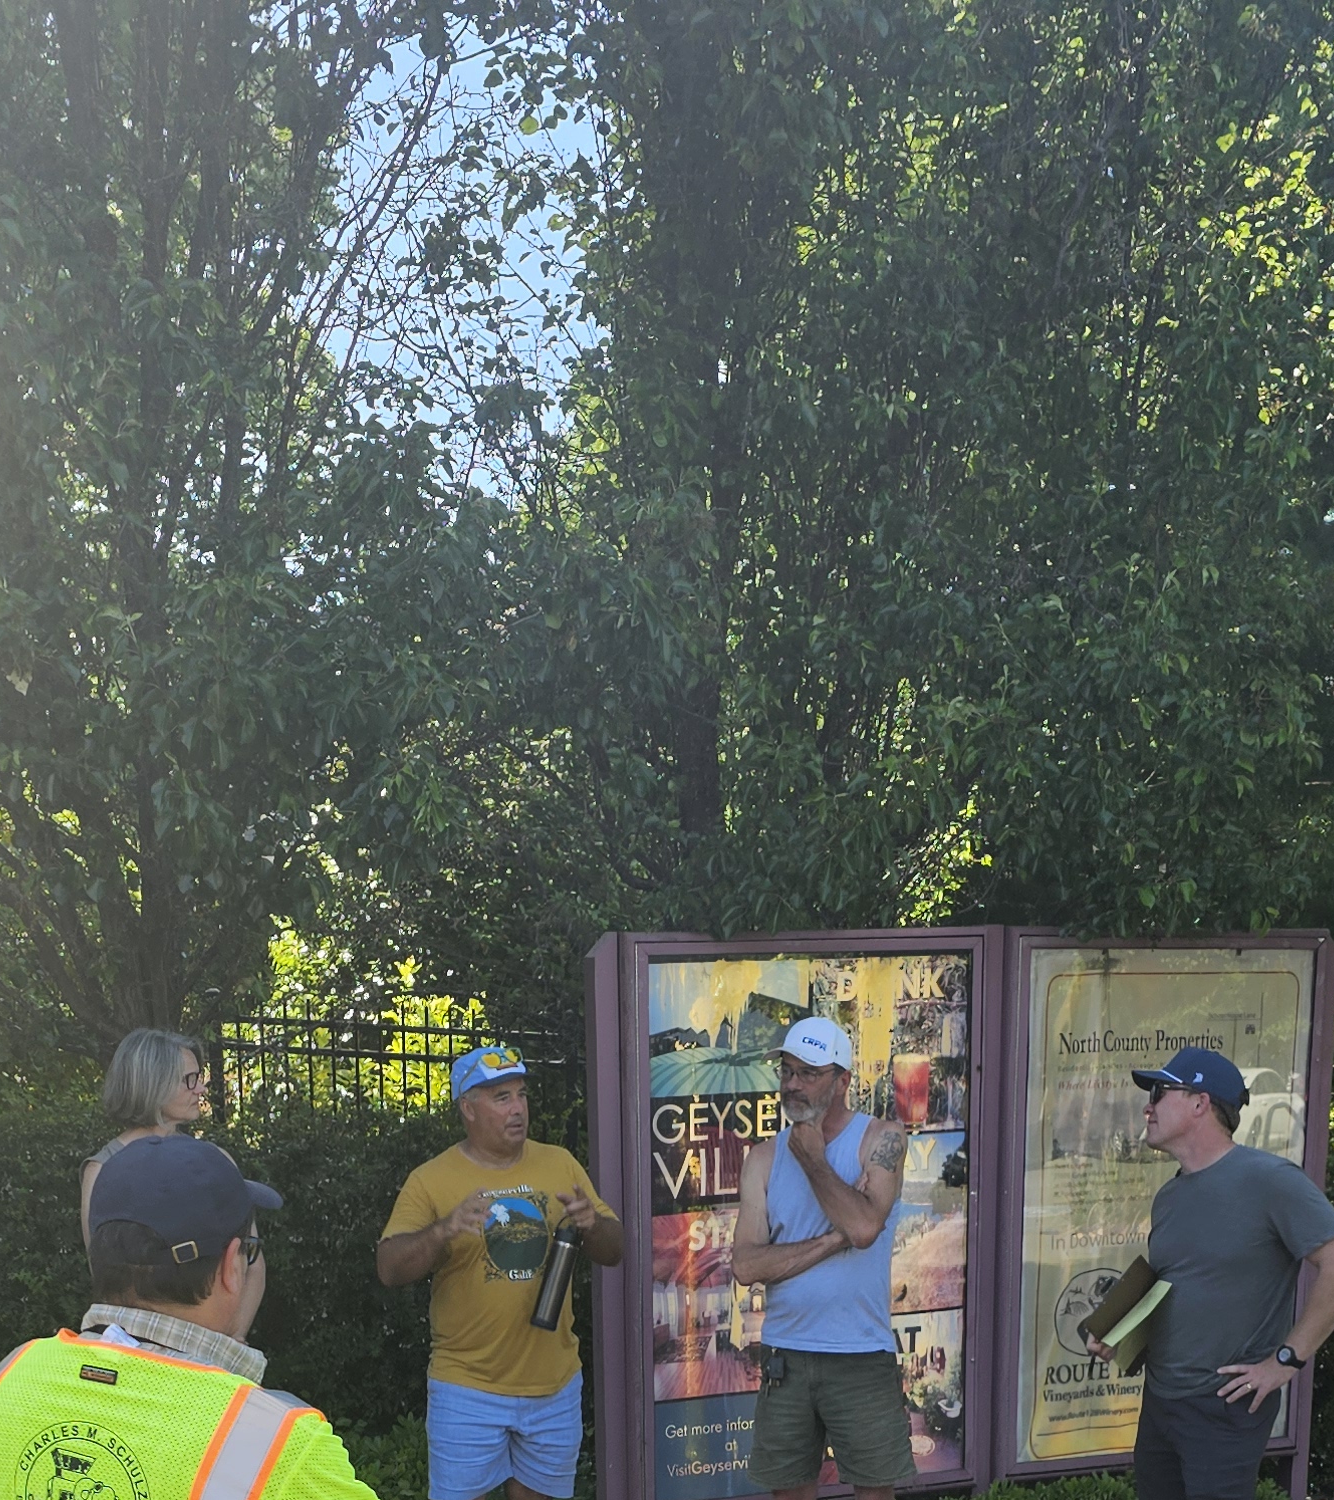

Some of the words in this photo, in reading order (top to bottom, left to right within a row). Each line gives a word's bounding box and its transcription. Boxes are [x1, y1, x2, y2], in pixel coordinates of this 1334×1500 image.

[837, 967, 945, 1001] DNK
[1058, 1031, 1101, 1055] North
[1103, 1029, 1151, 1059] County
[1154, 1028, 1224, 1051] Properties
[652, 1145, 750, 1199] VIL
[1051, 1233, 1066, 1250] In
[1070, 1230, 1146, 1248] Downtown
[1044, 1361, 1110, 1385] ROUTE
[1043, 1385, 1094, 1403] Vineyards
[1096, 1385, 1105, 1397] &
[1107, 1383, 1142, 1397] Winery
[665, 1424, 687, 1439] Get
[691, 1422, 723, 1436] more
[725, 1439, 738, 1452] at
[19, 1425, 79, 1472] CHARLES
[107, 1438, 148, 1500] SCHULZ
[667, 1454, 751, 1477] VisitGeyservi
